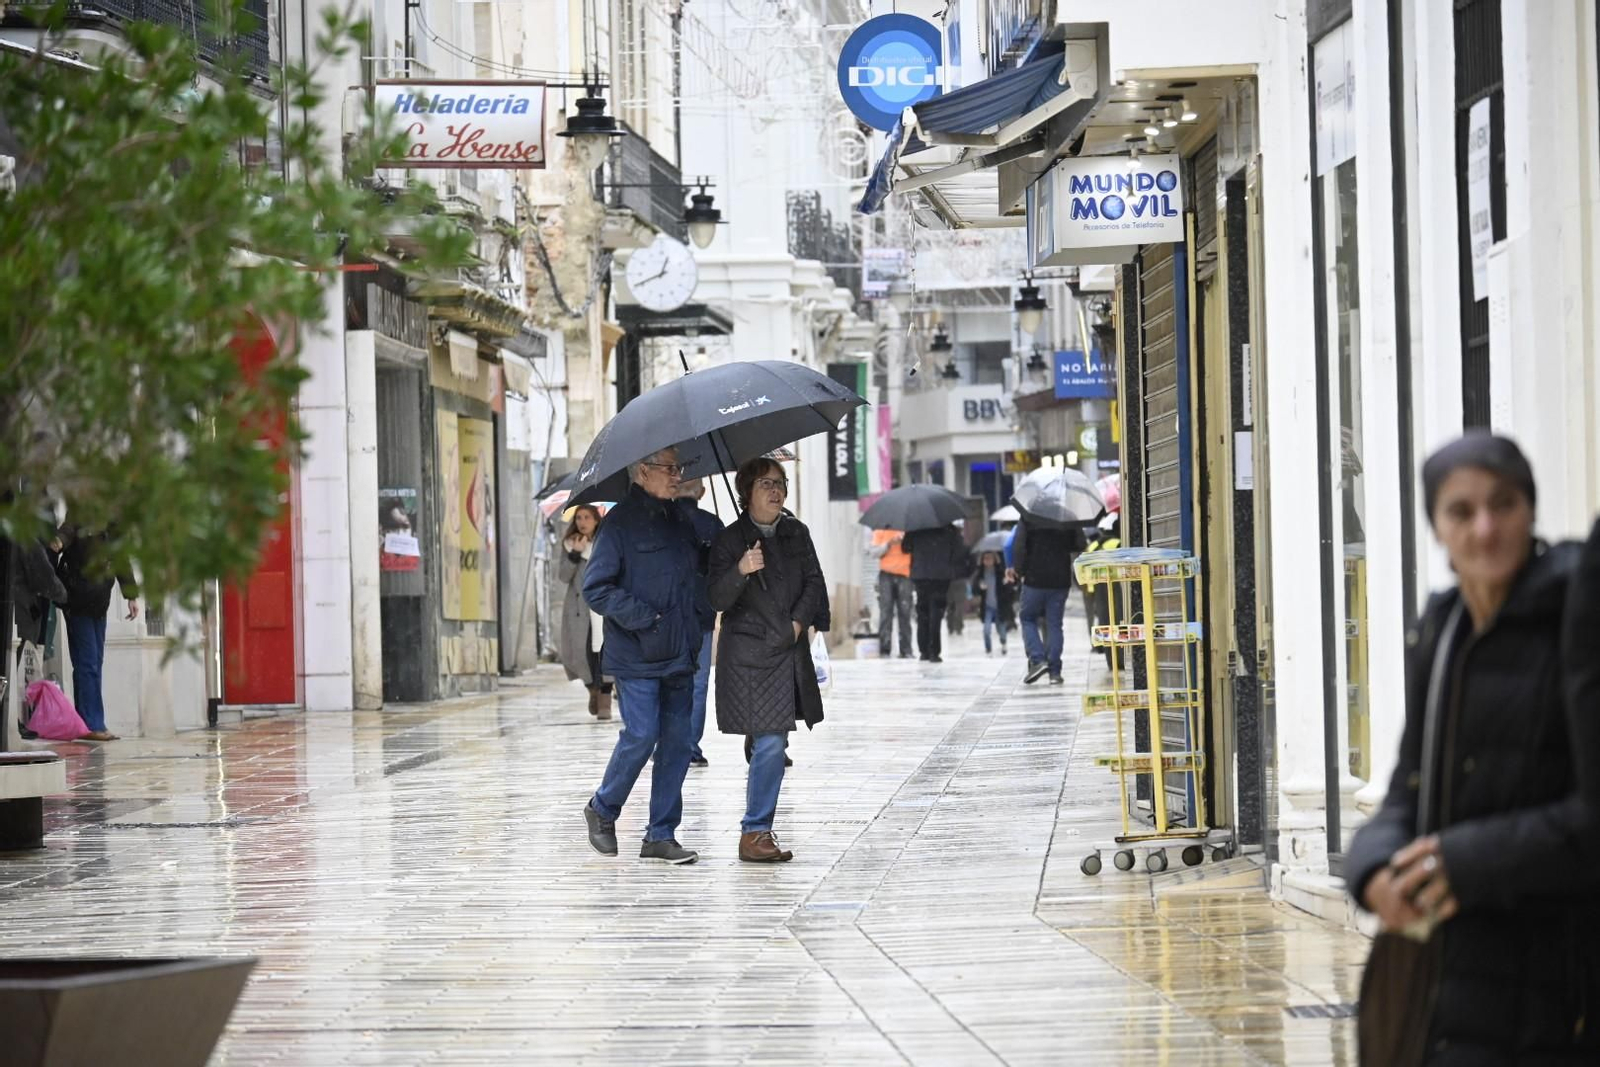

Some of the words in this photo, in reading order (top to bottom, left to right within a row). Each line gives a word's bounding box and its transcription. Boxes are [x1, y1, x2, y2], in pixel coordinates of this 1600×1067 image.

[1069, 170, 1177, 194] MUNDO
[1070, 194, 1178, 220] MOVIL
[836, 442, 849, 478] LOLA
